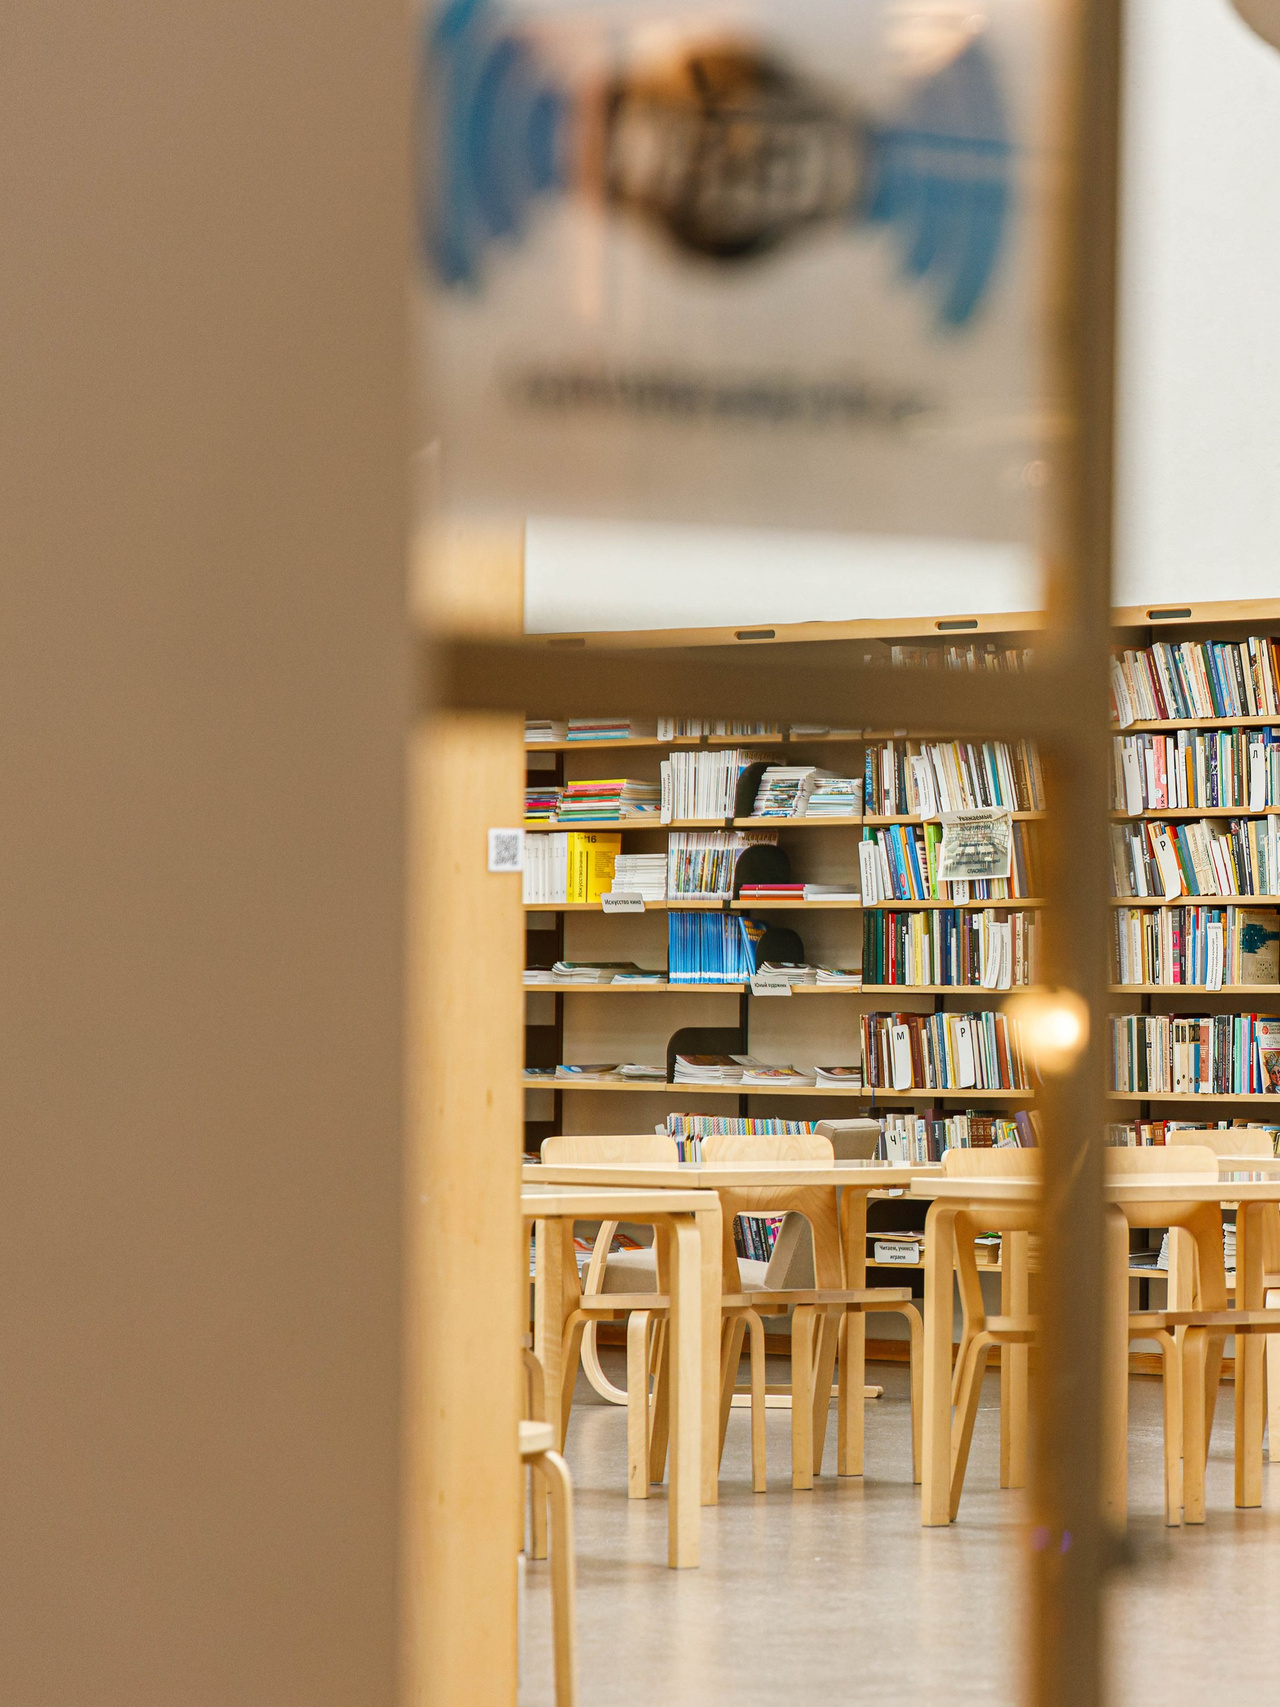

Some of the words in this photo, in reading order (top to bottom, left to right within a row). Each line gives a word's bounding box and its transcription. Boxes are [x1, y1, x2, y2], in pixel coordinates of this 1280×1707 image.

[1252, 750, 1259, 759] Л
[1159, 840, 1166, 852] Р
[896, 1031, 905, 1041] М
[960, 1027, 966, 1037] Р
[889, 1135, 897, 1146] Ч
